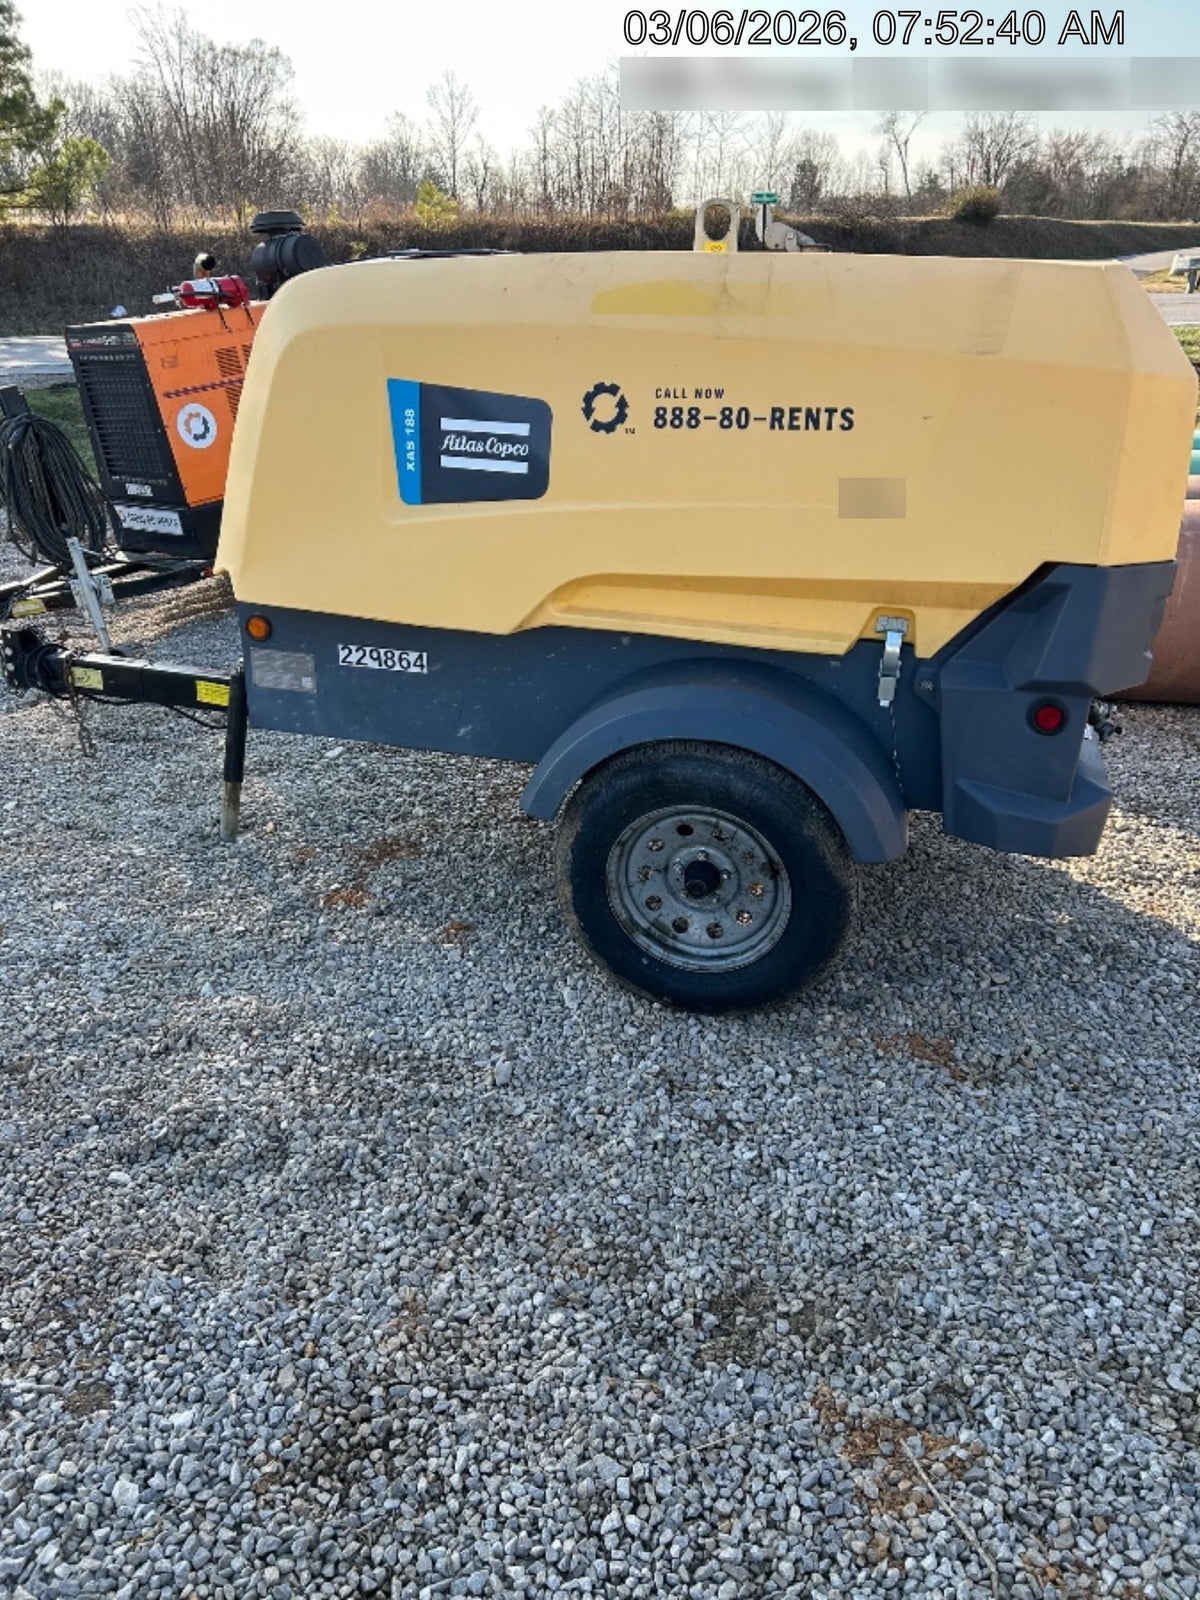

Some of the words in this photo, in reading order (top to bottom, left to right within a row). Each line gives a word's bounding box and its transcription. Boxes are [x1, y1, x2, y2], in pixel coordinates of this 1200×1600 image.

[655, 388, 687, 399] CALL
[694, 388, 725, 400] NOW
[404, 408, 415, 436] 188
[653, 406, 855, 431] 888-80-RENTS
[406, 441, 415, 472] XAS
[440, 434, 484, 453] Atlas
[485, 436, 529, 458] Copco
[339, 645, 426, 672] 229864
